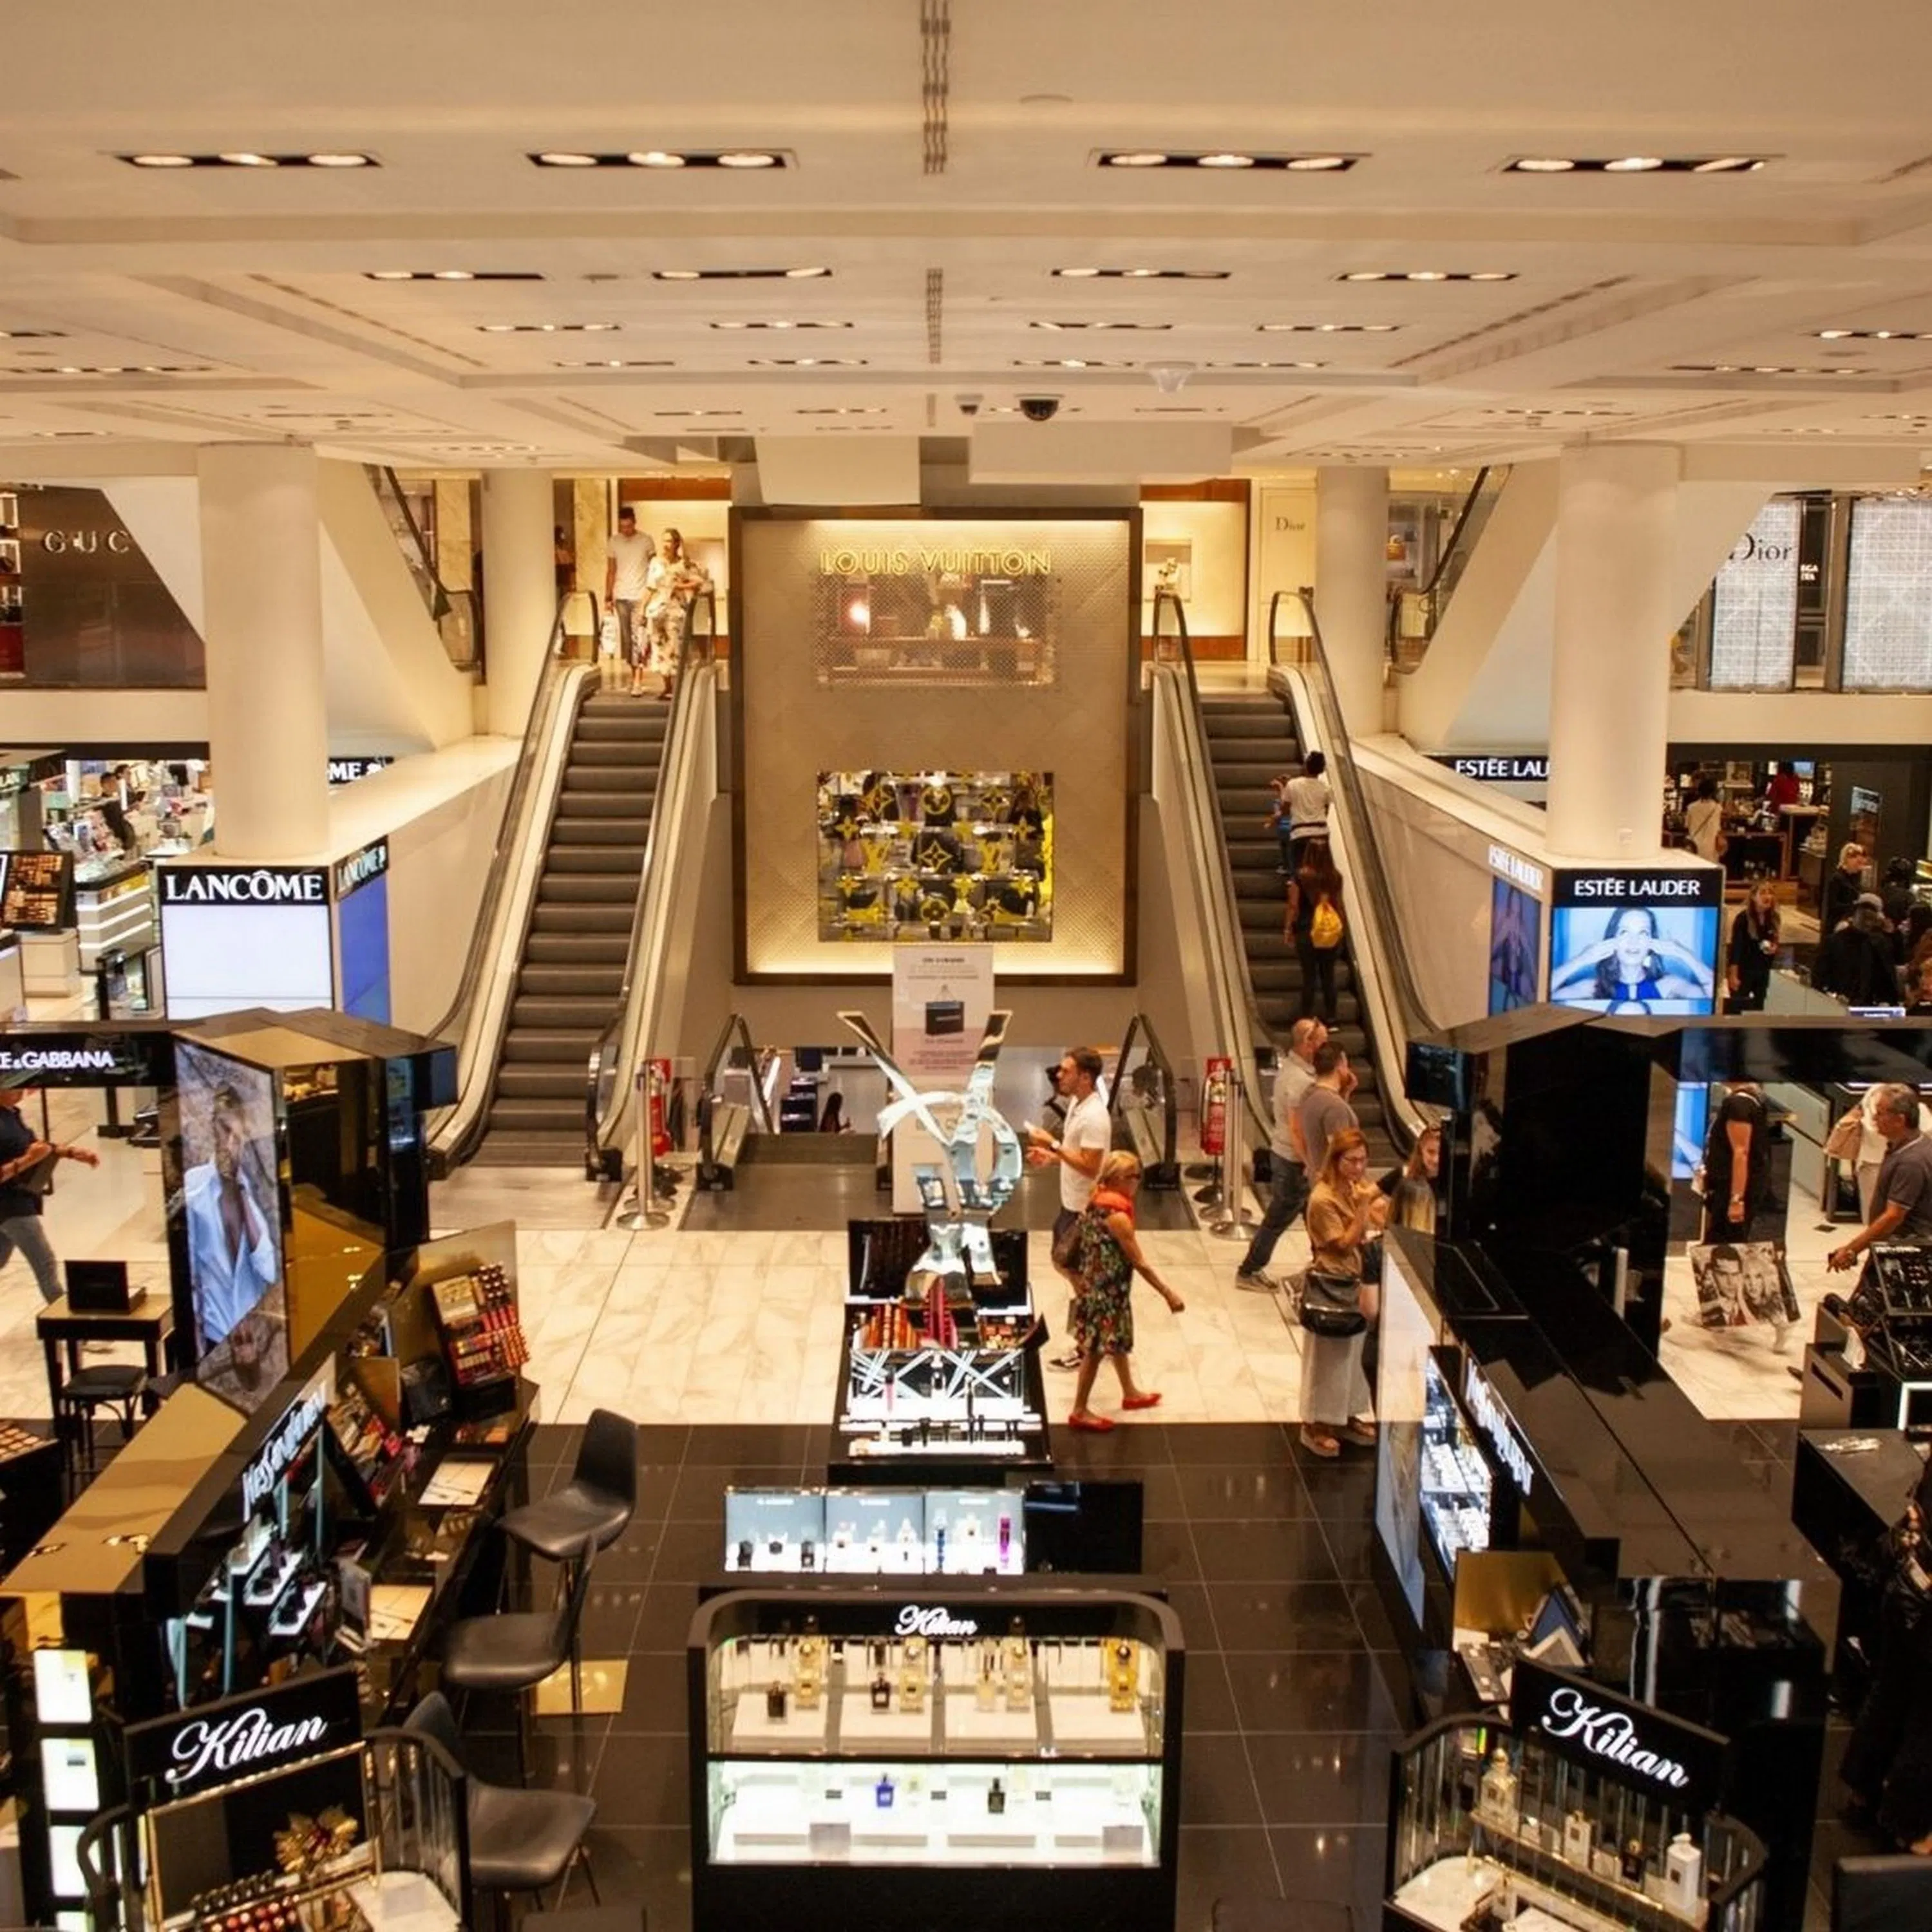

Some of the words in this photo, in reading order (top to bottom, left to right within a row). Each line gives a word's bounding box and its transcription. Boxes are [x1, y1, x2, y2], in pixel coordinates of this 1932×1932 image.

[819, 550, 909, 574] LOUIS
[919, 550, 1051, 574] VUITTON
[165, 869, 323, 900] LANCÔME
[1629, 880, 1701, 896] LAUDER
[895, 1605, 978, 1636] Kilian
[164, 1707, 328, 1784] Kilian
[1541, 1687, 1690, 1788] Kilian
